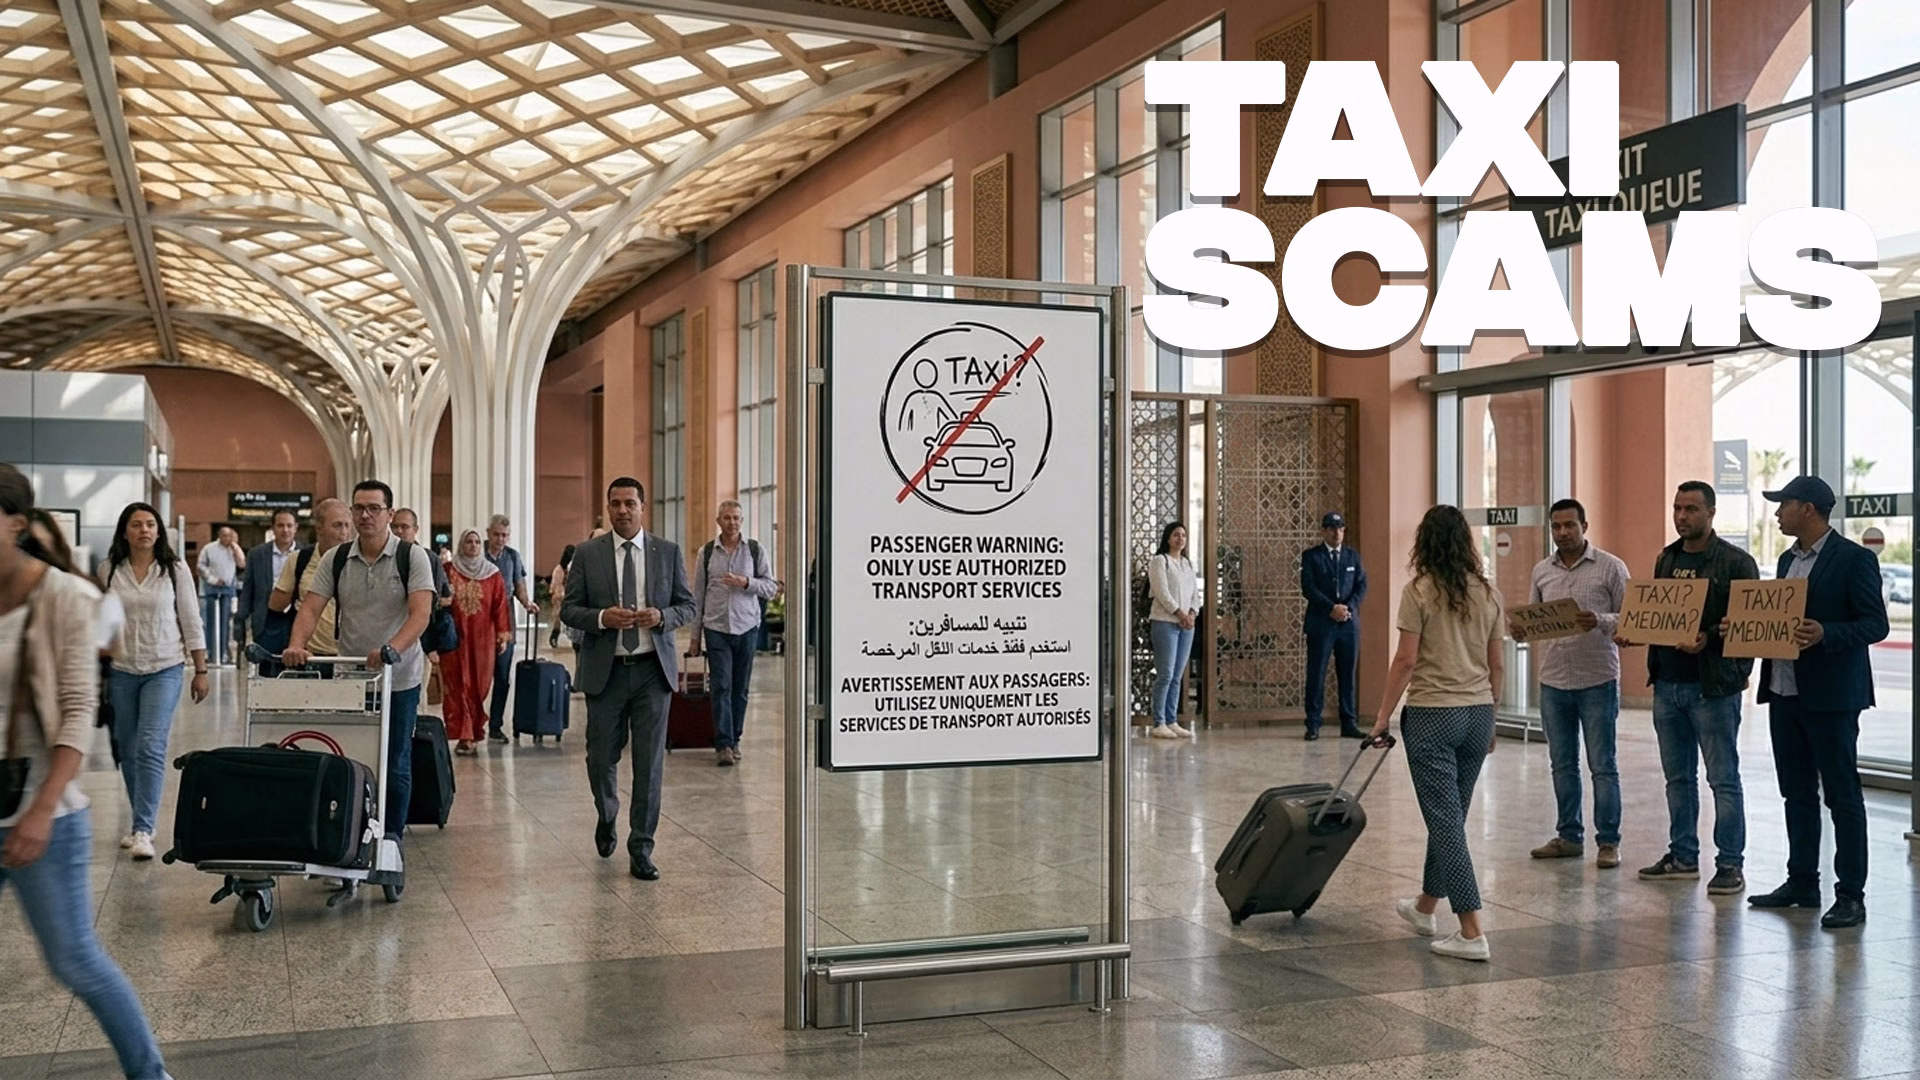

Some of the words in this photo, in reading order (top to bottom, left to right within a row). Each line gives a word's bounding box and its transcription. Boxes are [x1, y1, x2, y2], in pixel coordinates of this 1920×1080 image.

[1850, 496, 1890, 515] TAXI
[1490, 510, 1515, 523] TAXI
[871, 536, 972, 553] PASSENGER
[977, 537, 1063, 553] WARNING:
[867, 560, 913, 576] ONLY
[919, 560, 951, 575] USE
[956, 560, 1066, 575] AUTHORIZED
[872, 582, 978, 599] TRANSPORT
[982, 582, 1061, 598] SERVICES
[1635, 584, 1693, 607] TAXI?
[1742, 586, 1795, 613] TAXI?
[910, 614, 988, 636] للمسافرين:
[1623, 608, 1699, 633] MEDINA?
[1729, 617, 1800, 644] MEDINA?
[862, 641, 919, 660] المرخصة
[958, 642, 999, 654] خدمات
[842, 676, 964, 692] AVERTISSEMENT
[969, 675, 998, 689] AUX
[1004, 672, 1089, 688] PASSAGERS:
[875, 696, 936, 711] UTILISEZ
[940, 693, 1032, 711] UNIQUEMENT
[1036, 693, 1058, 706] LES
[840, 717, 905, 732] SERVICES
[910, 716, 927, 730] DE
[931, 713, 1013, 729] TRANSPORT
[1017, 708, 1090, 726] AUTORISÉS
